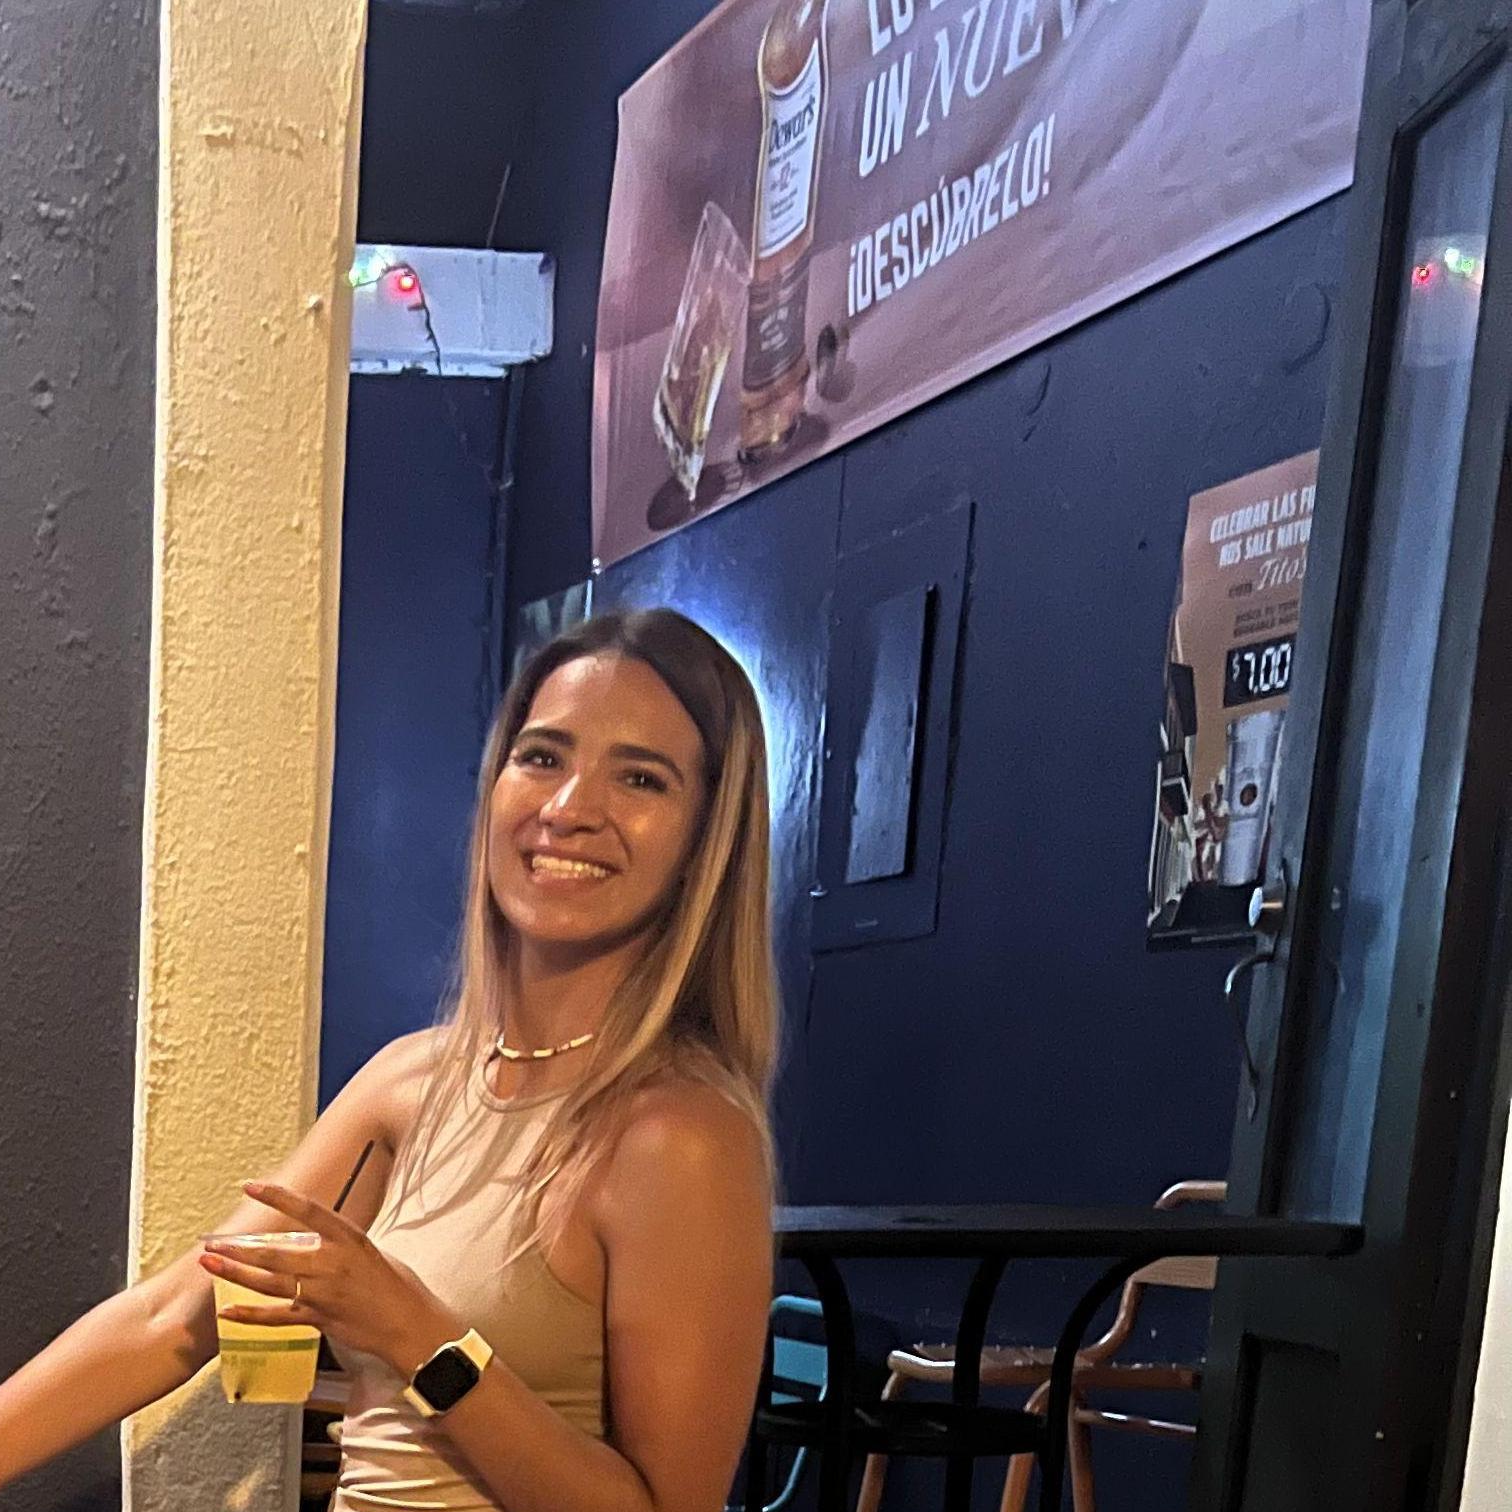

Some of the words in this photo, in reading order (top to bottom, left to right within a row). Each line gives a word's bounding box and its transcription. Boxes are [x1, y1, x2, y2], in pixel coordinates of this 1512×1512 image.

[859, 52, 912, 177] UN
[848, 112, 1055, 318] ¡DESCÚBRELO!
[1272, 491, 1297, 522] LAS
[1244, 528, 1274, 561] SALE
[1231, 642, 1292, 694] $7.00
